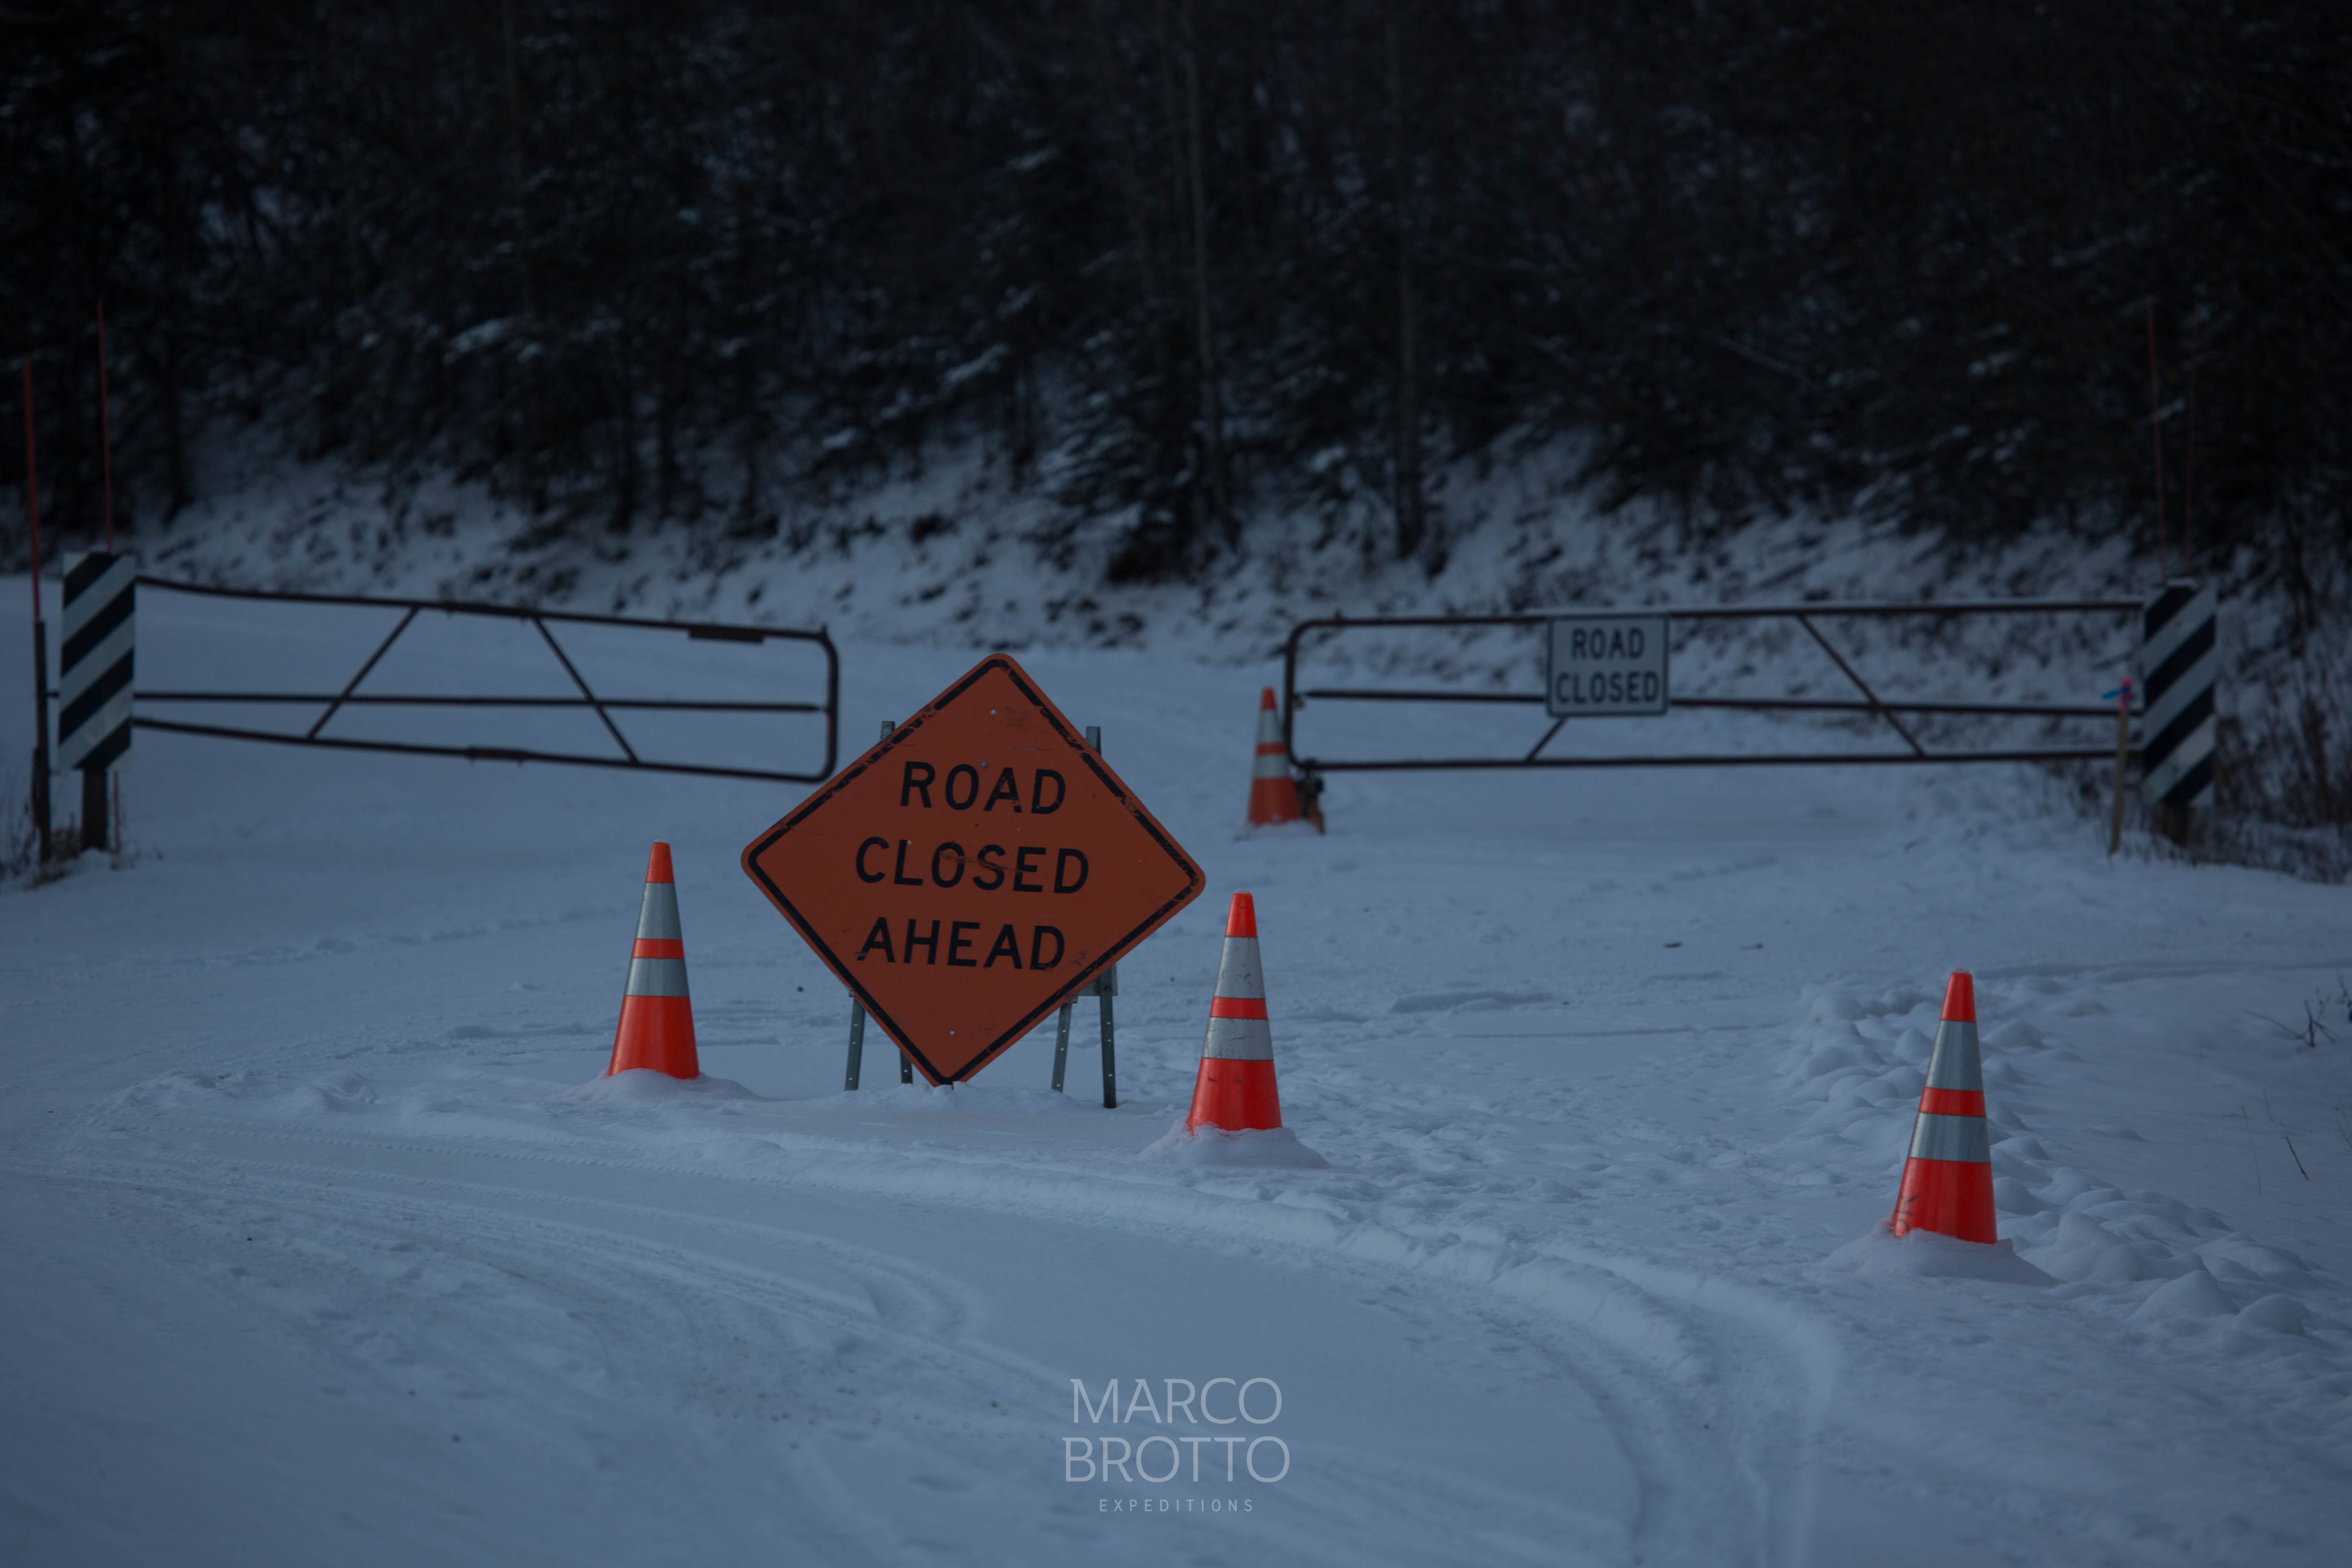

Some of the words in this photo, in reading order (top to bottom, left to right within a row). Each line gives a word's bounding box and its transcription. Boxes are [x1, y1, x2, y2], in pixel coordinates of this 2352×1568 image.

[1572, 628, 1645, 659] ROAD
[1556, 672, 1659, 704] CLOSED
[900, 761, 1066, 814] ROAD
[855, 837, 1089, 894] CLOSED
[856, 917, 1065, 970] AHEAD
